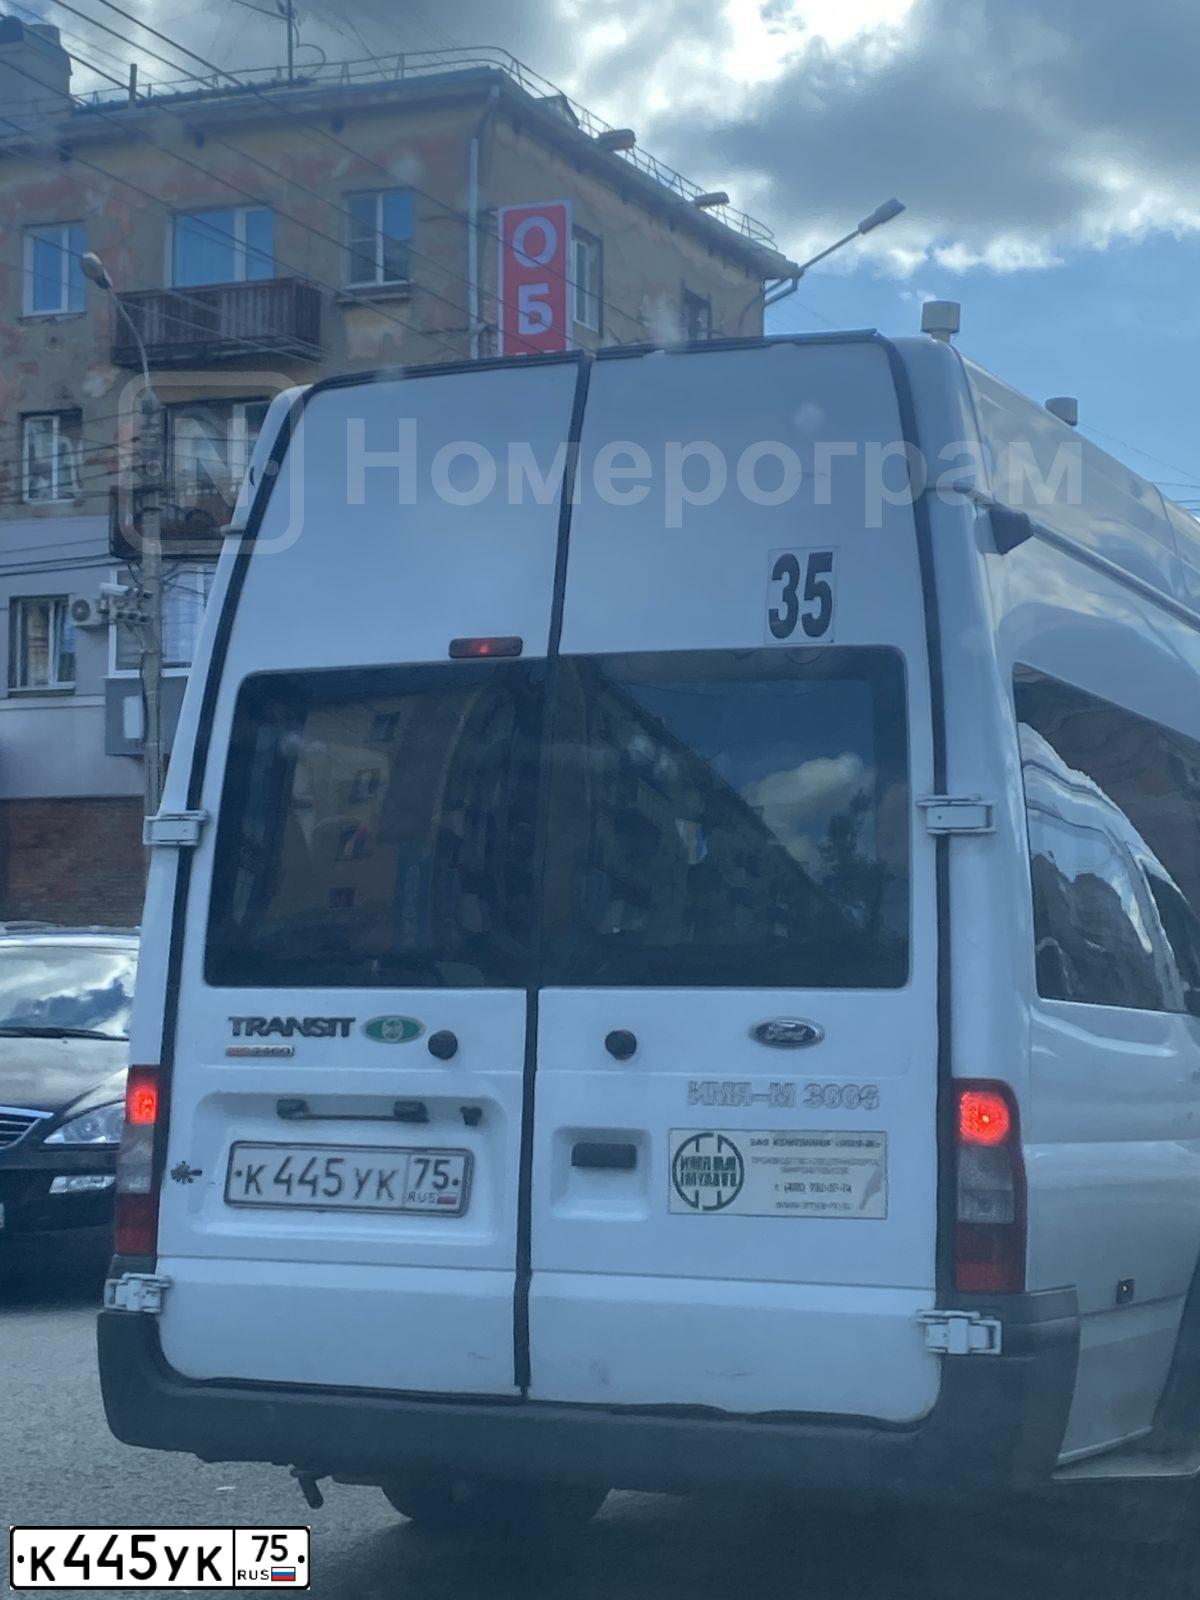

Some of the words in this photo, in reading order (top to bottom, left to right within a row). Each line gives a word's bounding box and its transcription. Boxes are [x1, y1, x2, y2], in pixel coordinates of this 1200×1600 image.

[511, 215, 558, 355] ОБ
[768, 551, 833, 639] 35
[227, 1016, 356, 1038] TRANSIT
[767, 1022, 808, 1041] Ford
[414, 1158, 451, 1191] 75
[406, 1191, 438, 1204] RUS
